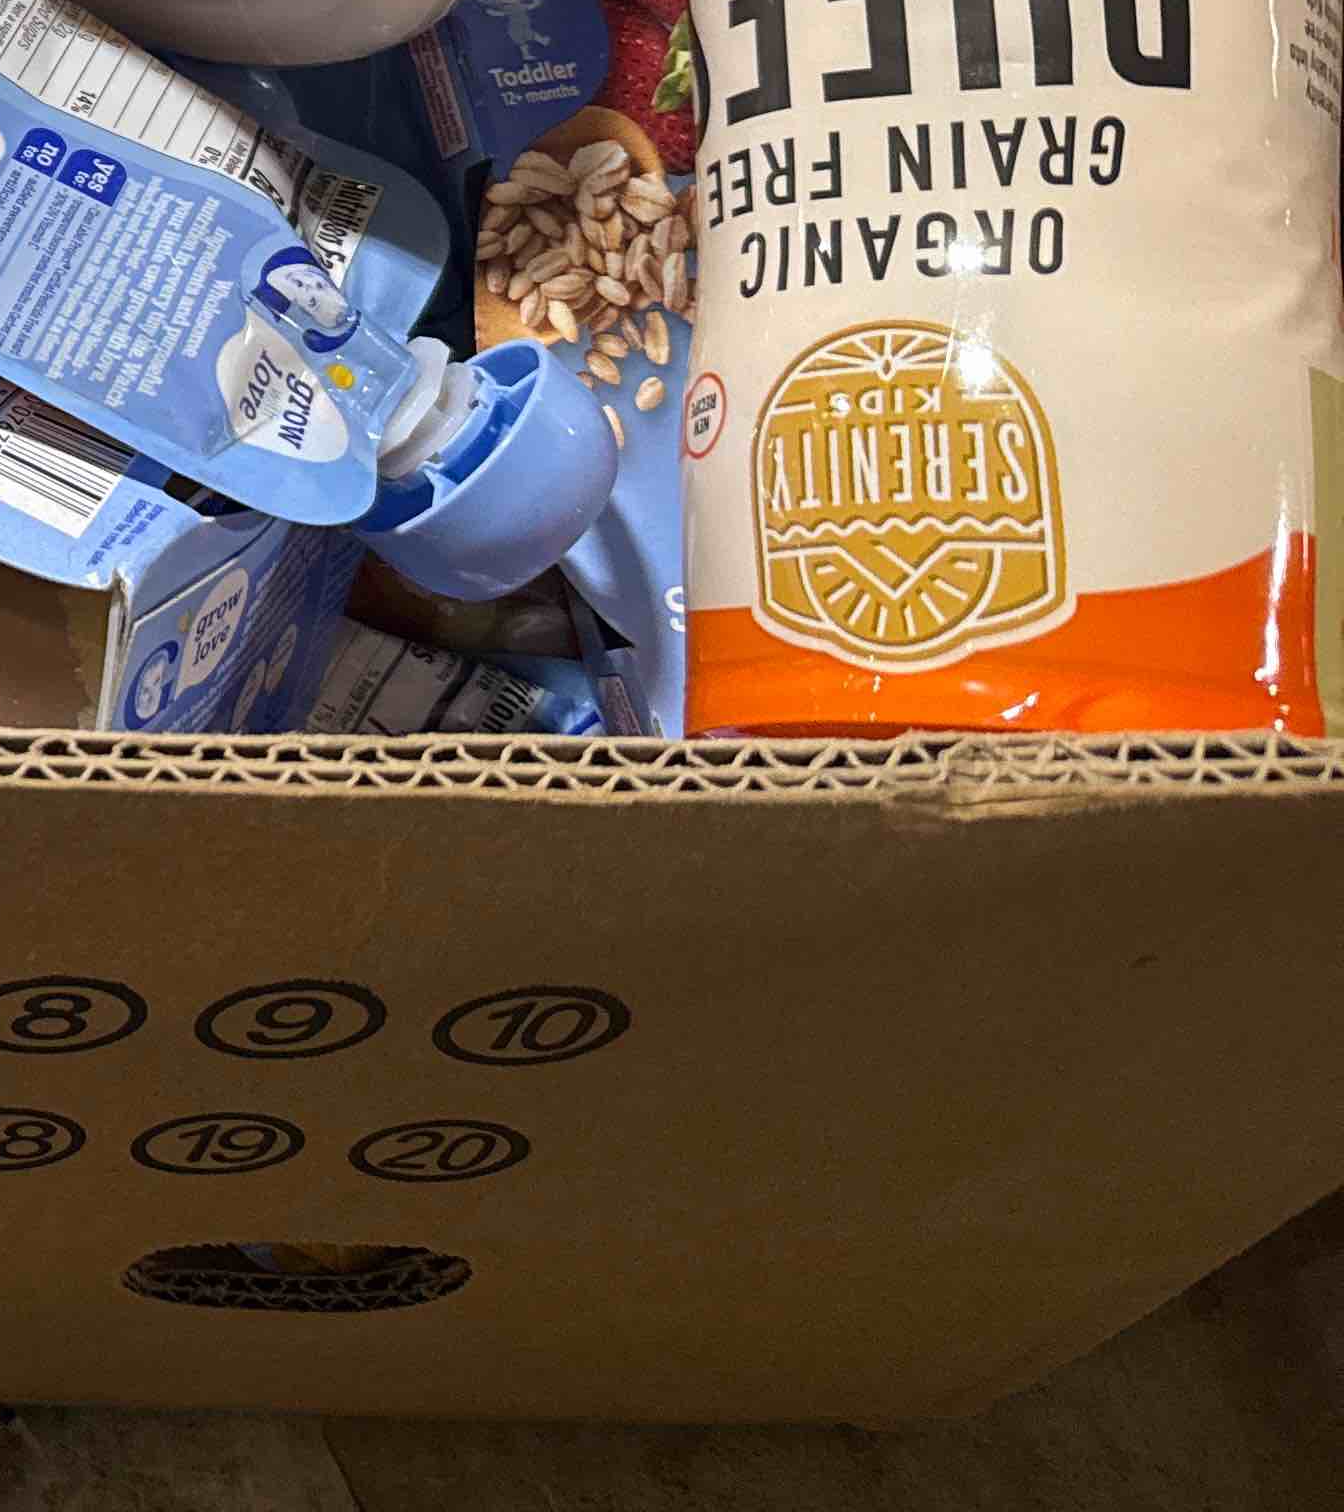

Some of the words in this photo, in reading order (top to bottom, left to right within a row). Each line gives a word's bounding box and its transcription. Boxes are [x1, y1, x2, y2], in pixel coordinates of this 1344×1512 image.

[488, 58, 578, 90] Toddler
[525, 82, 580, 106] months
[19, 144, 39, 160] to:
[36, 141, 60, 167] no
[88, 158, 119, 194] yes
[886, 115, 1127, 195] GRAIN
[705, 130, 845, 232] FREE
[738, 207, 1066, 301] ORGANIC
[240, 349, 283, 420] love
[277, 373, 314, 450] grow
[766, 417, 1030, 518] SERENITY
[195, 587, 243, 640] grow
[192, 623, 231, 665] love
